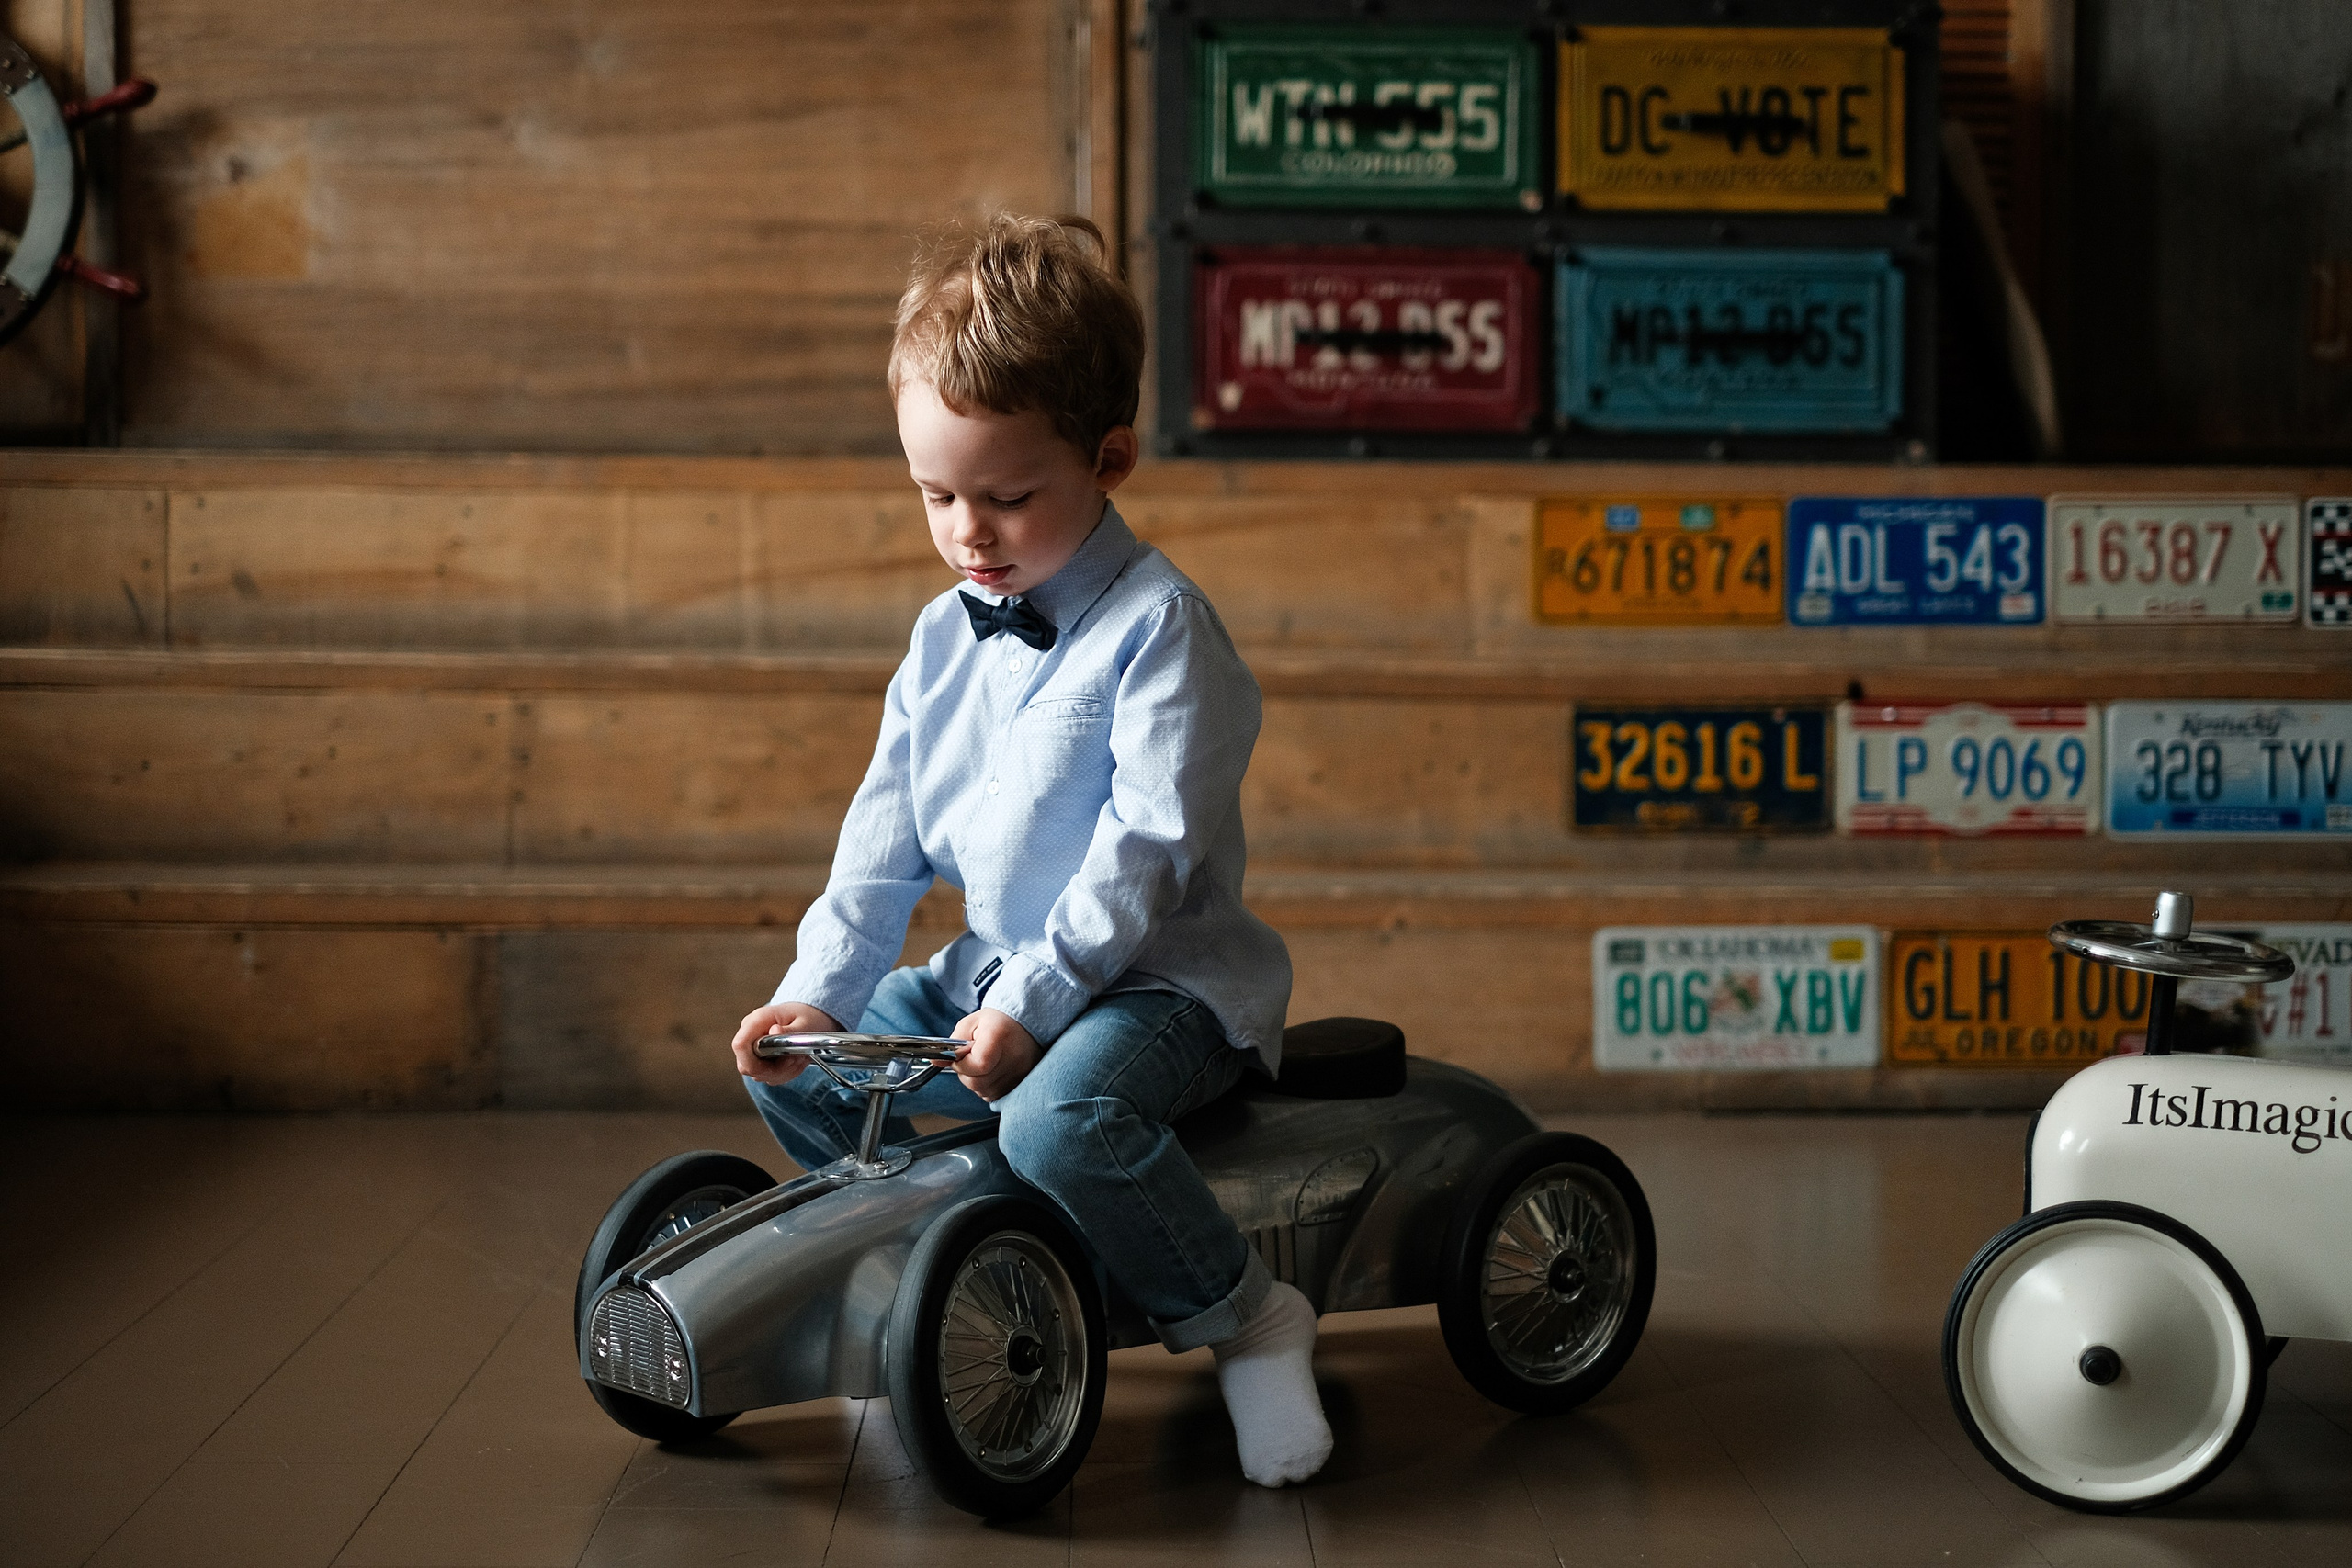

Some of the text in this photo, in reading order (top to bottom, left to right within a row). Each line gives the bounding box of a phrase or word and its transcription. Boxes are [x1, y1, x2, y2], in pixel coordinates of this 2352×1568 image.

[1600, 84, 1870, 158] DC VOTE
[1573, 536, 1771, 595] 671874
[1804, 522, 2030, 595] ADL 543
[2064, 520, 2233, 585] 16387
[2256, 521, 2284, 584] X
[1579, 720, 1819, 793] 32616 L
[1856, 736, 2086, 802] LP 9069
[2136, 739, 2344, 803] 328 TYV
[1615, 968, 1866, 1037] 806 XBV
[1905, 947, 2148, 1021] GLH 100
[1957, 1026, 2098, 1056] OREGON
